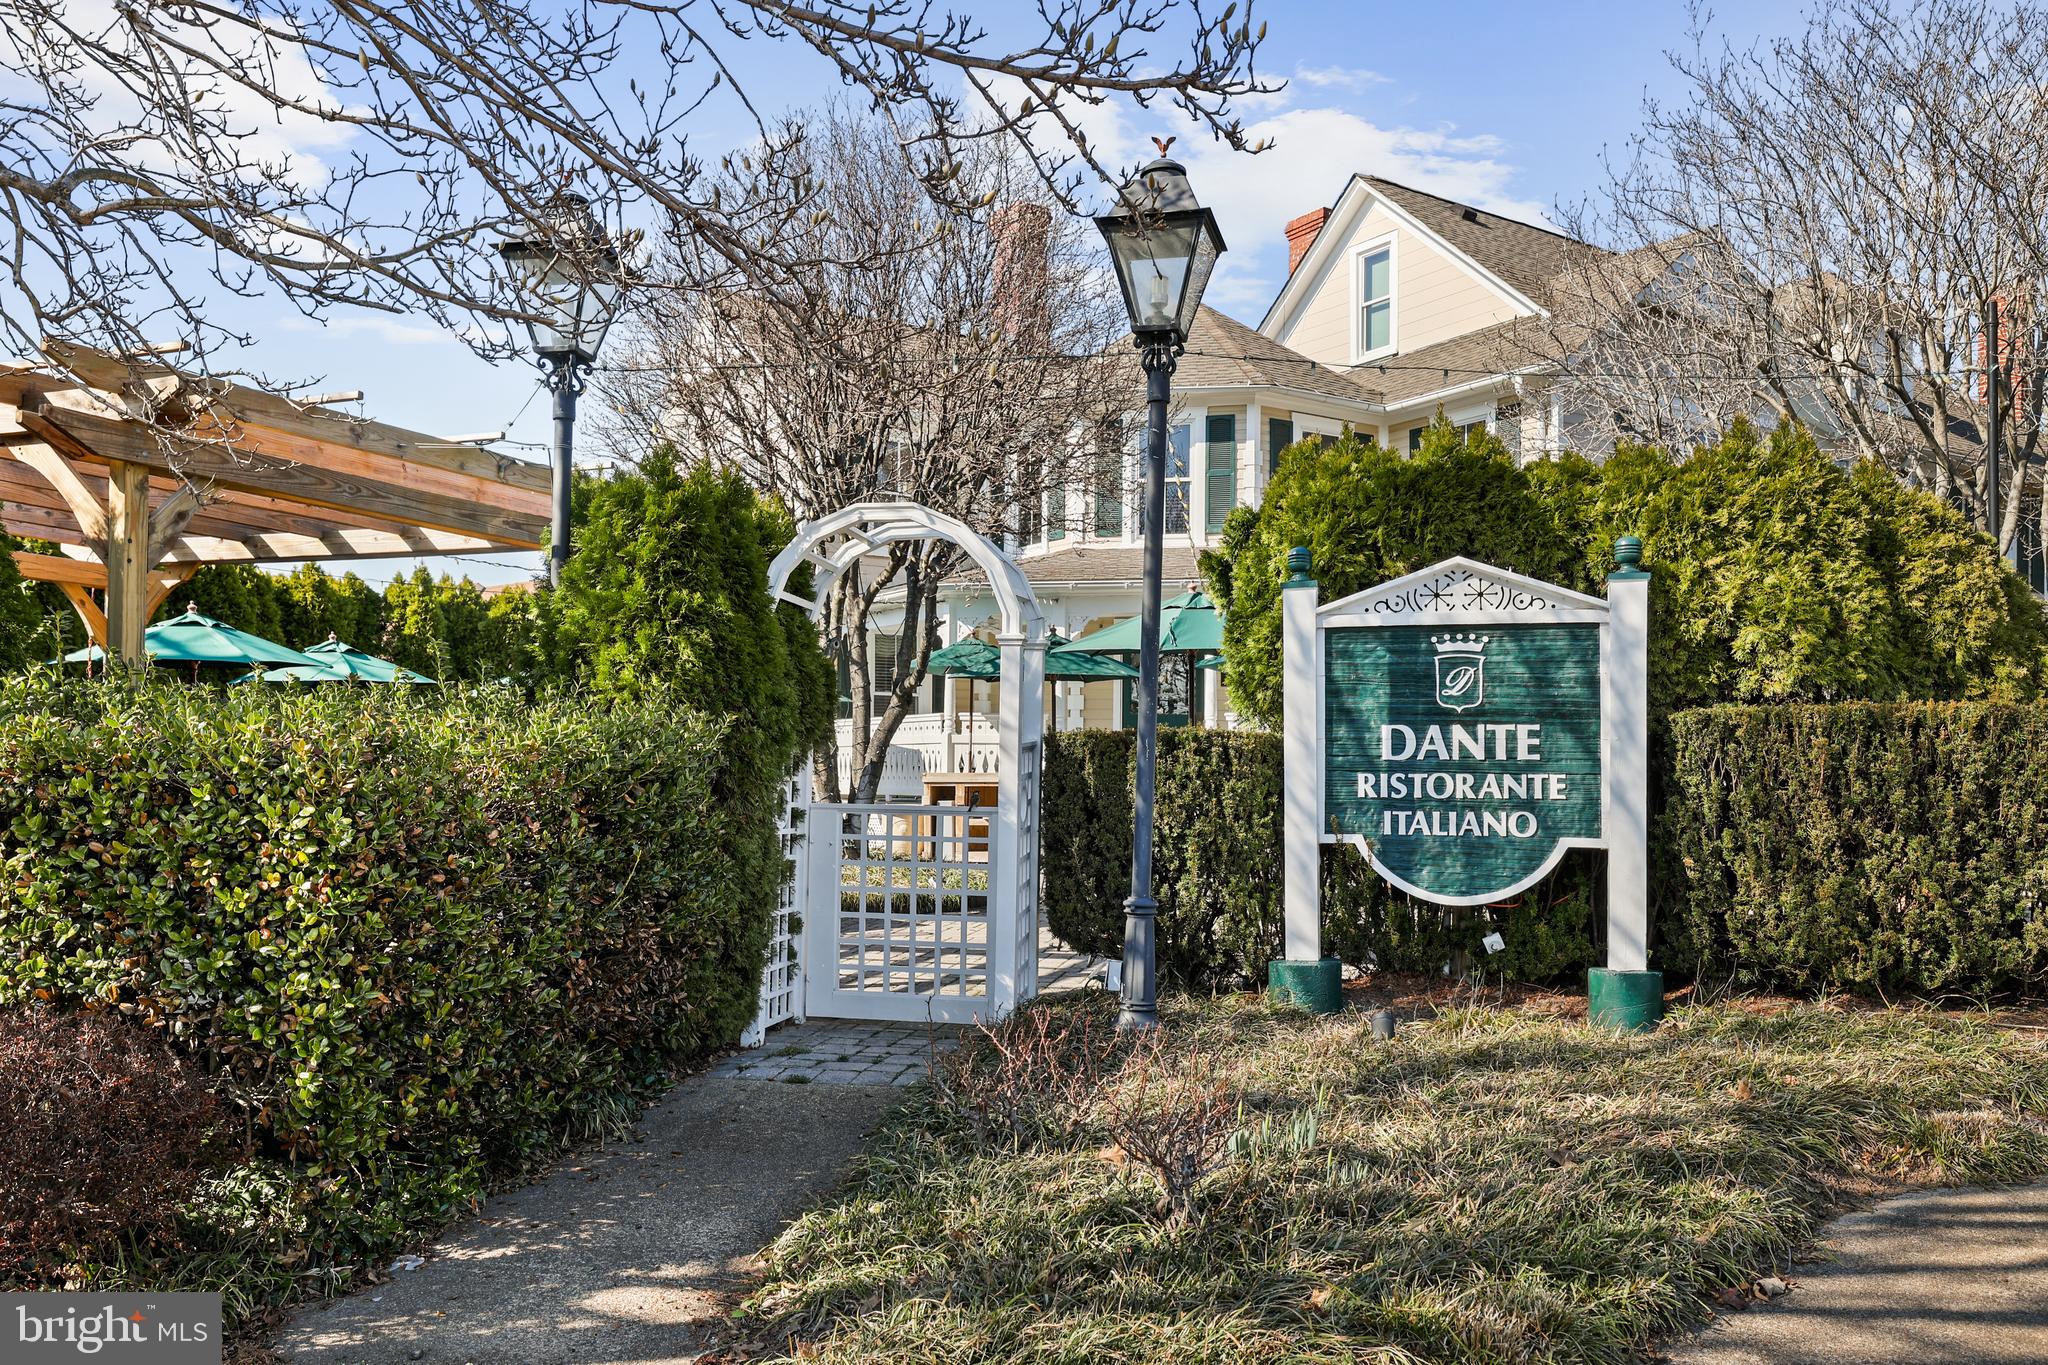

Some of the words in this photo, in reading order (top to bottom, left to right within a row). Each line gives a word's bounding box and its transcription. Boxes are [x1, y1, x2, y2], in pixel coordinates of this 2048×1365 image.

[1381, 723, 1541, 761] DANTE
[1357, 773, 1567, 800] RISTORANTE
[1382, 809, 1538, 838] ITALIANO
